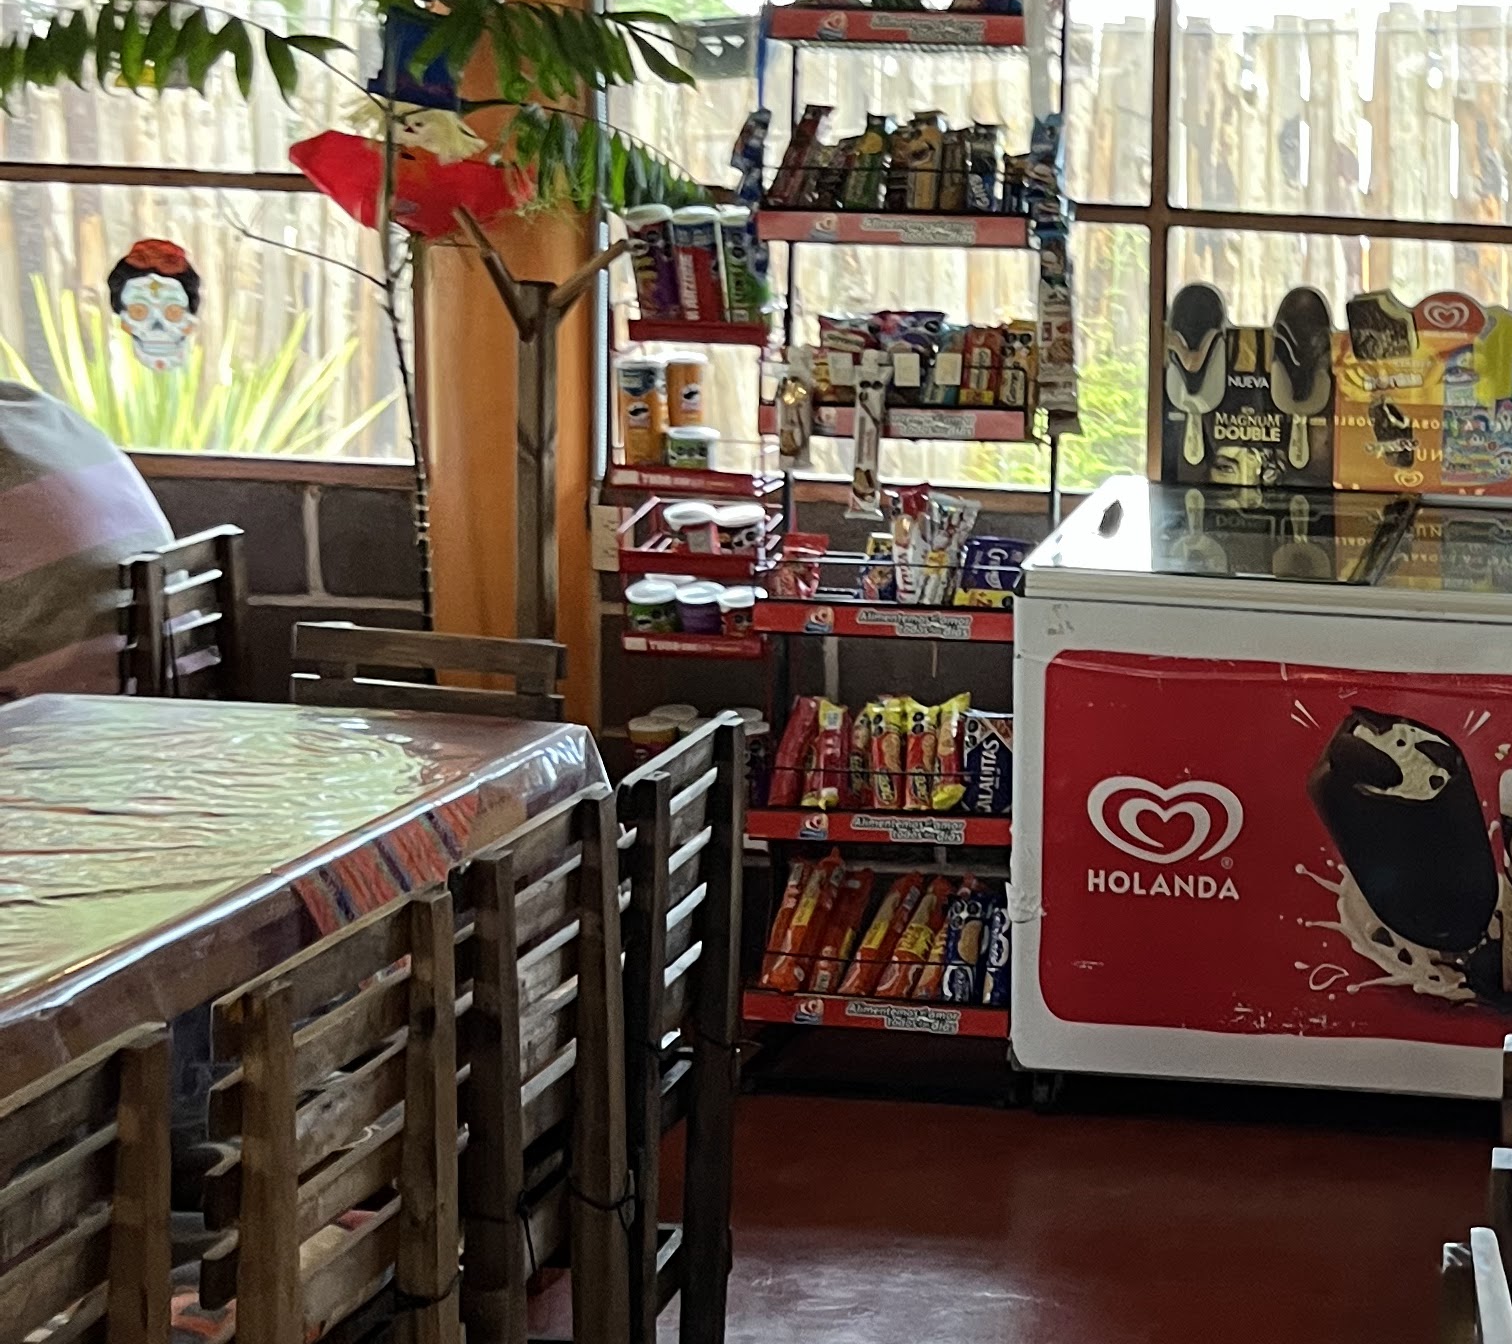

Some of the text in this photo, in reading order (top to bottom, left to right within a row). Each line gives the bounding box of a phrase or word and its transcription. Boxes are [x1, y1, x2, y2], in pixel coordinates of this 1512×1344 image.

[1227, 374, 1270, 389] NUEVA
[1214, 411, 1281, 428] MAGNUM
[1213, 425, 1281, 443] DOUBLE
[1087, 858, 1241, 900] HOLANDA
